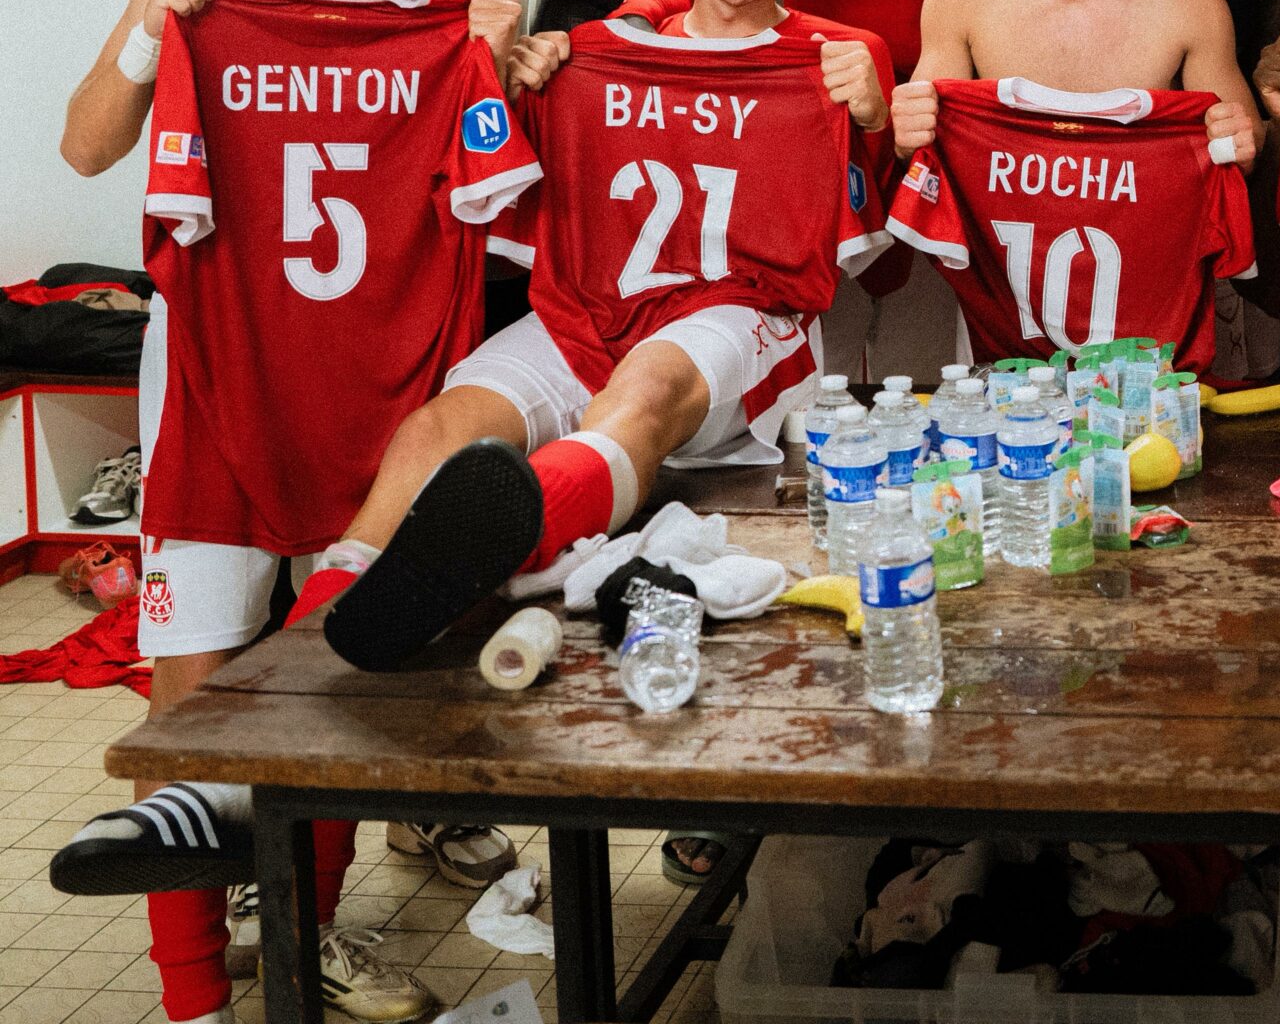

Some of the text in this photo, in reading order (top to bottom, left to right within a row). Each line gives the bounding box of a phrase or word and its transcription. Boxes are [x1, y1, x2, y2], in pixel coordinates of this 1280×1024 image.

[222, 64, 421, 115] GENTON
[605, 83, 758, 139] BA-SY
[475, 106, 500, 137] N
[988, 151, 1137, 203] ROCHA
[283, 142, 369, 301] 5
[609, 159, 738, 299] 21
[990, 219, 1122, 358] 10
